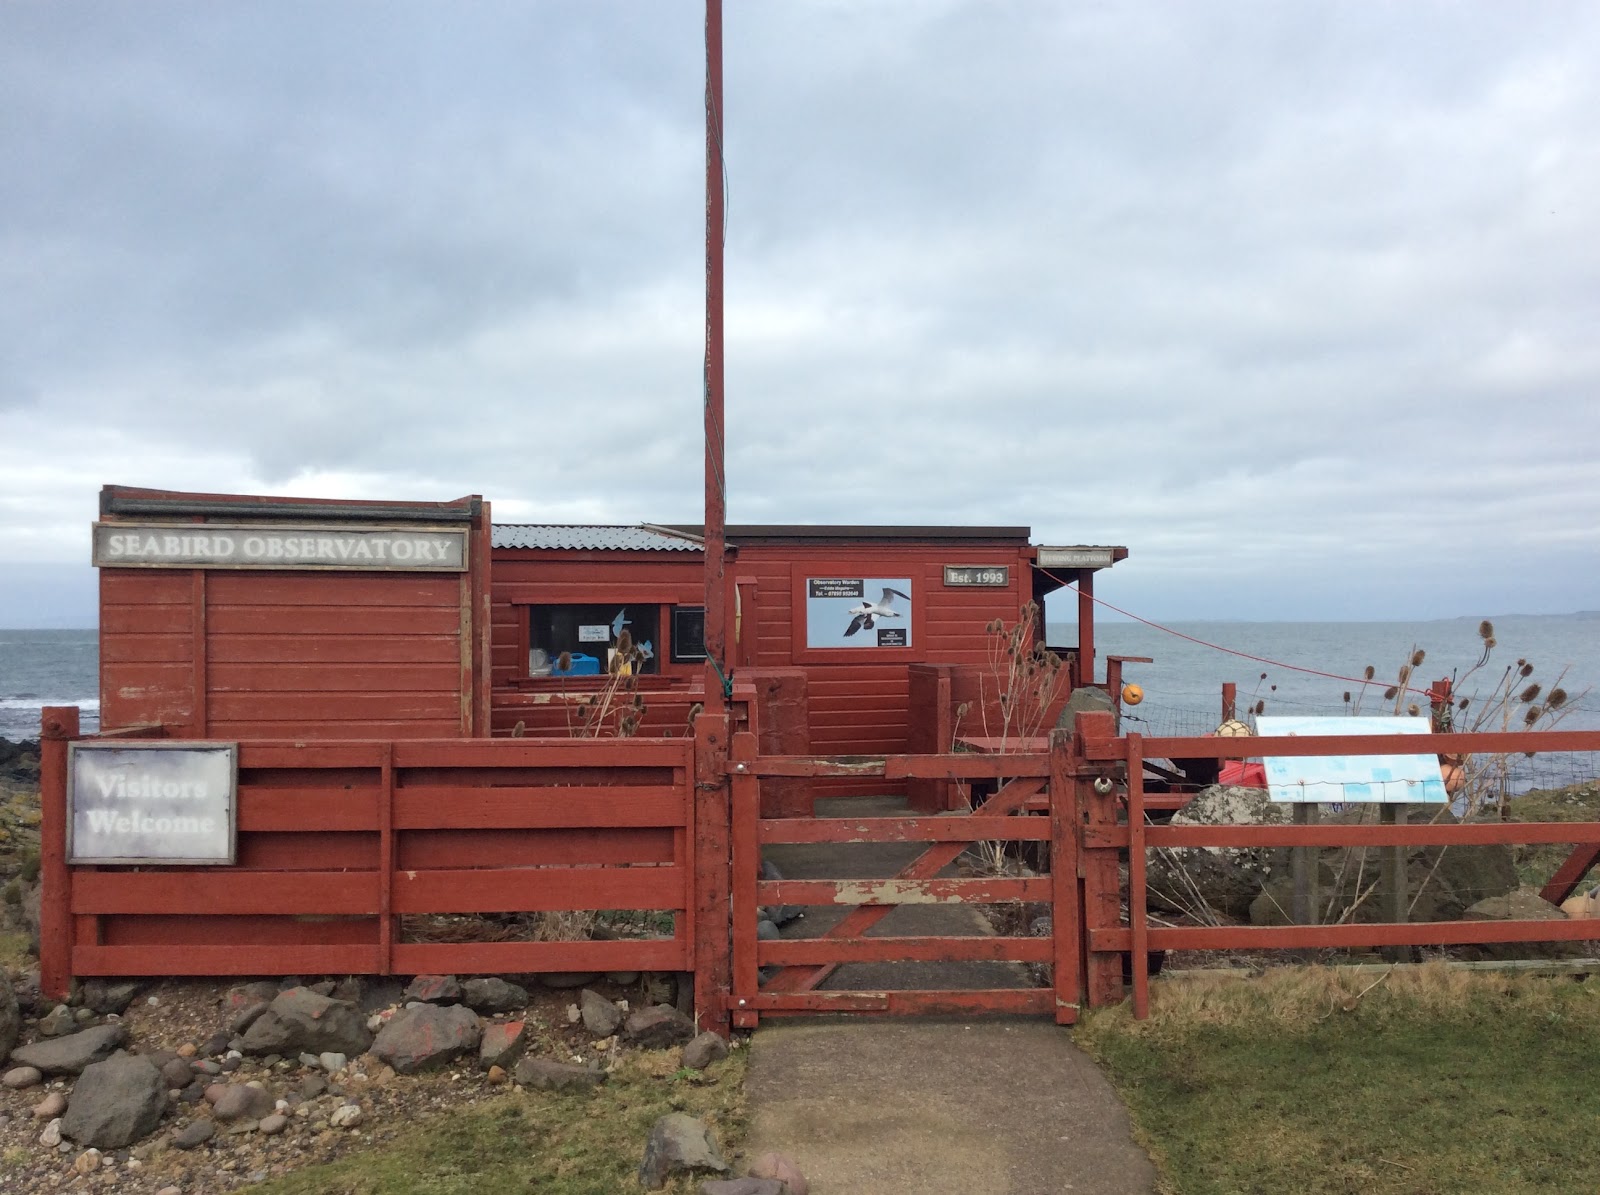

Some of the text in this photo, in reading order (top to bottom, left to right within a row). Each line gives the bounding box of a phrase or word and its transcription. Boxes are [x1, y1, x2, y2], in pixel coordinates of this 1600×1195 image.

[109, 535, 452, 561] SEABIRD OBSERVATORY
[950, 572, 1003, 584] Est. 1993
[95, 773, 208, 798] Visitors
[86, 809, 217, 833] Welcome
